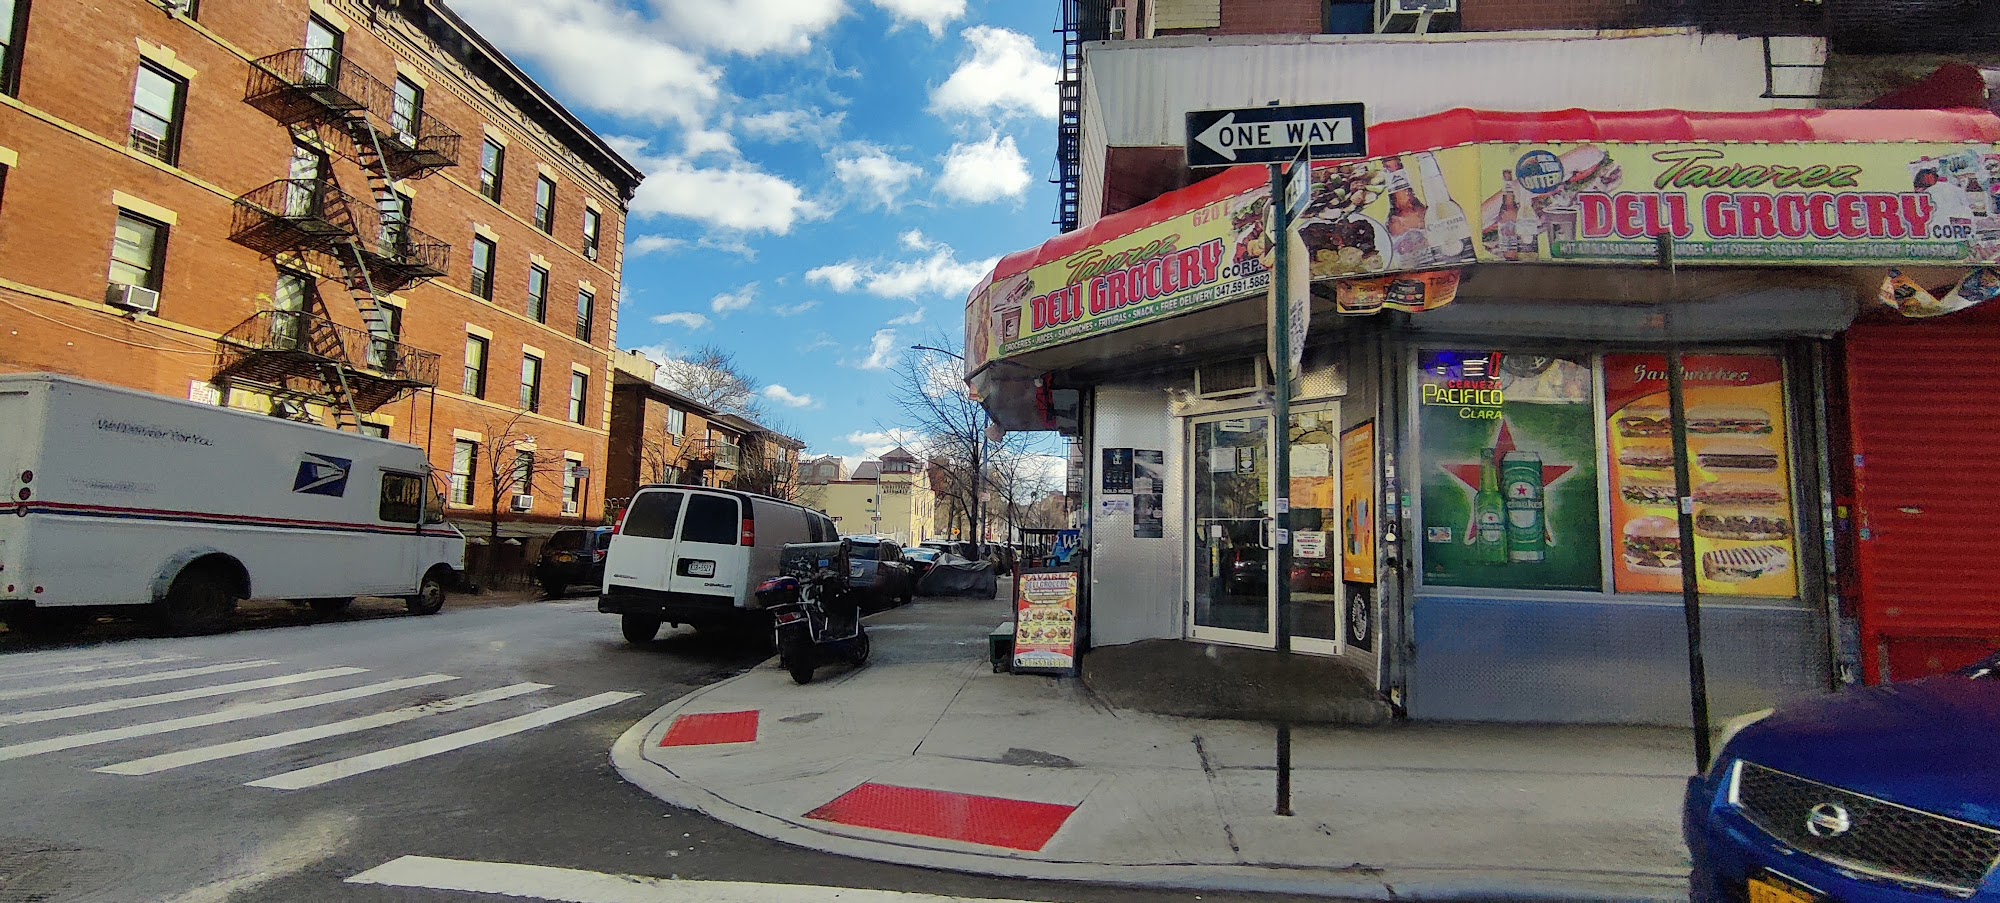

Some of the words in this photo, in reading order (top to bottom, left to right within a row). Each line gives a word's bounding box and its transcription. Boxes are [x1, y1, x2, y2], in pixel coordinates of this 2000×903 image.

[1219, 125, 1271, 147] ONE
[1286, 121, 1340, 144] WAY
[1652, 149, 1863, 190] Tavarez
[1192, 207, 1220, 228] 620
[1577, 191, 1693, 240] DELI
[1703, 191, 1936, 240] GROCERY
[1932, 224, 1975, 239] CORP.
[1066, 233, 1181, 286] Tavarez
[1030, 283, 1085, 332] DELI
[1089, 237, 1225, 316] GROCERY
[1222, 260, 1262, 279] CORP.
[1004, 339, 1032, 352] GROCERIES
[1036, 332, 1053, 344] JUICES
[1058, 321, 1093, 337] SANDWICHES
[1098, 312, 1127, 327] FRITURAS
[1132, 304, 1155, 319] SNACK
[1160, 298, 1178, 310] FREE
[1180, 288, 1214, 307] DELIVERY
[1215, 273, 1270, 297] 347.591.5882
[1423, 384, 1504, 405] PACIFICO
[1448, 380, 1503, 390] CERVEZA
[1459, 407, 1503, 420] CLARA
